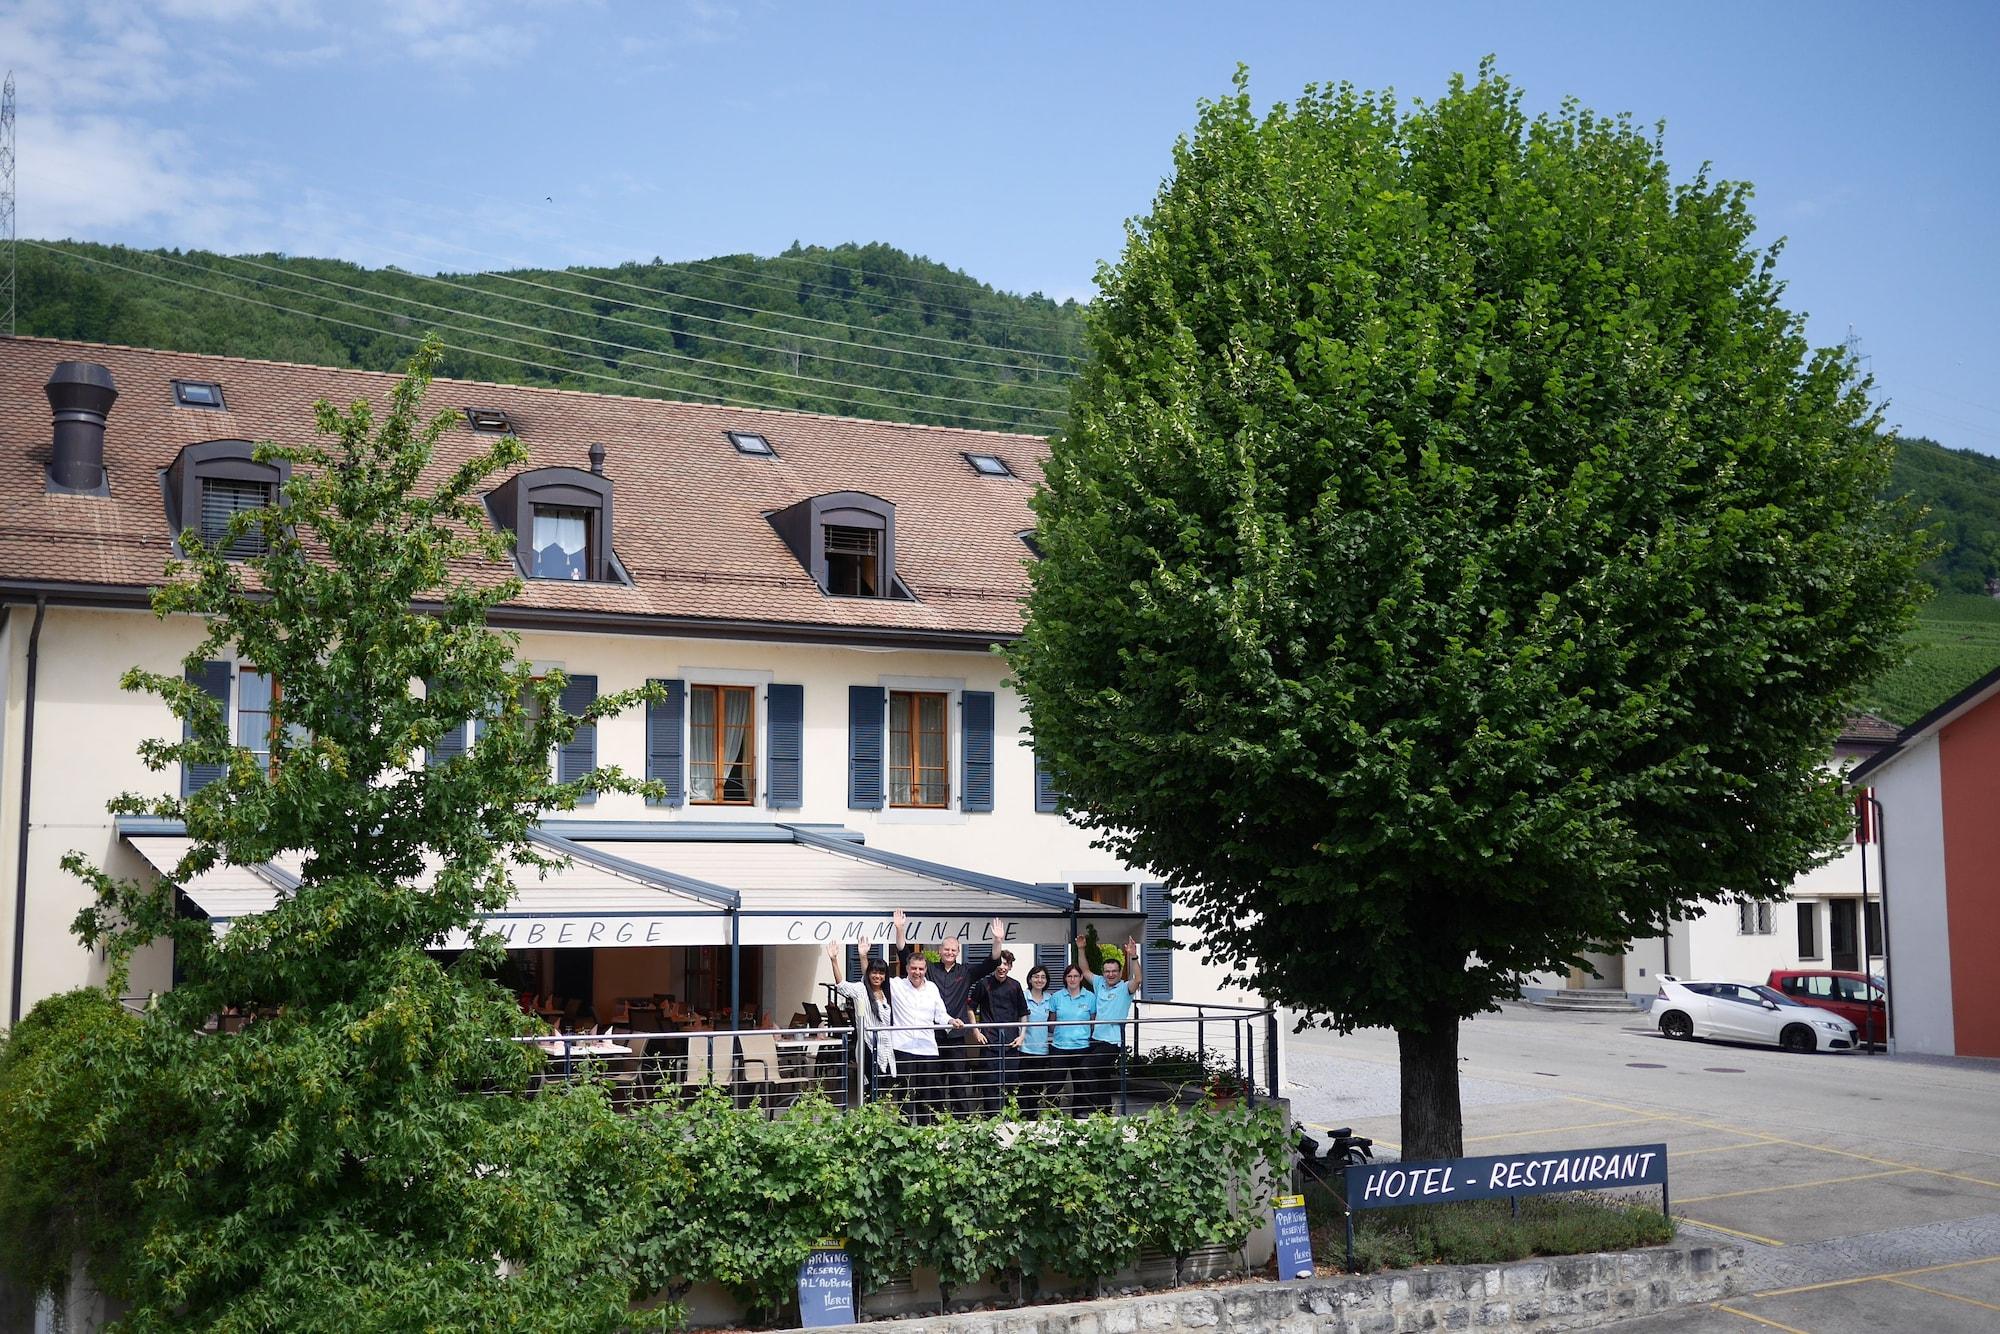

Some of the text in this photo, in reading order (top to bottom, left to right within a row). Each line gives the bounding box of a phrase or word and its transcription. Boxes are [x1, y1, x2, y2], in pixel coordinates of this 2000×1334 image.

[464, 921, 1019, 944] UBERGE COMMUNALE
[1364, 1166, 1455, 1201] HOTEL
[1490, 1152, 1657, 1190] RESTAURANT
[803, 1252, 849, 1266] ARKING
